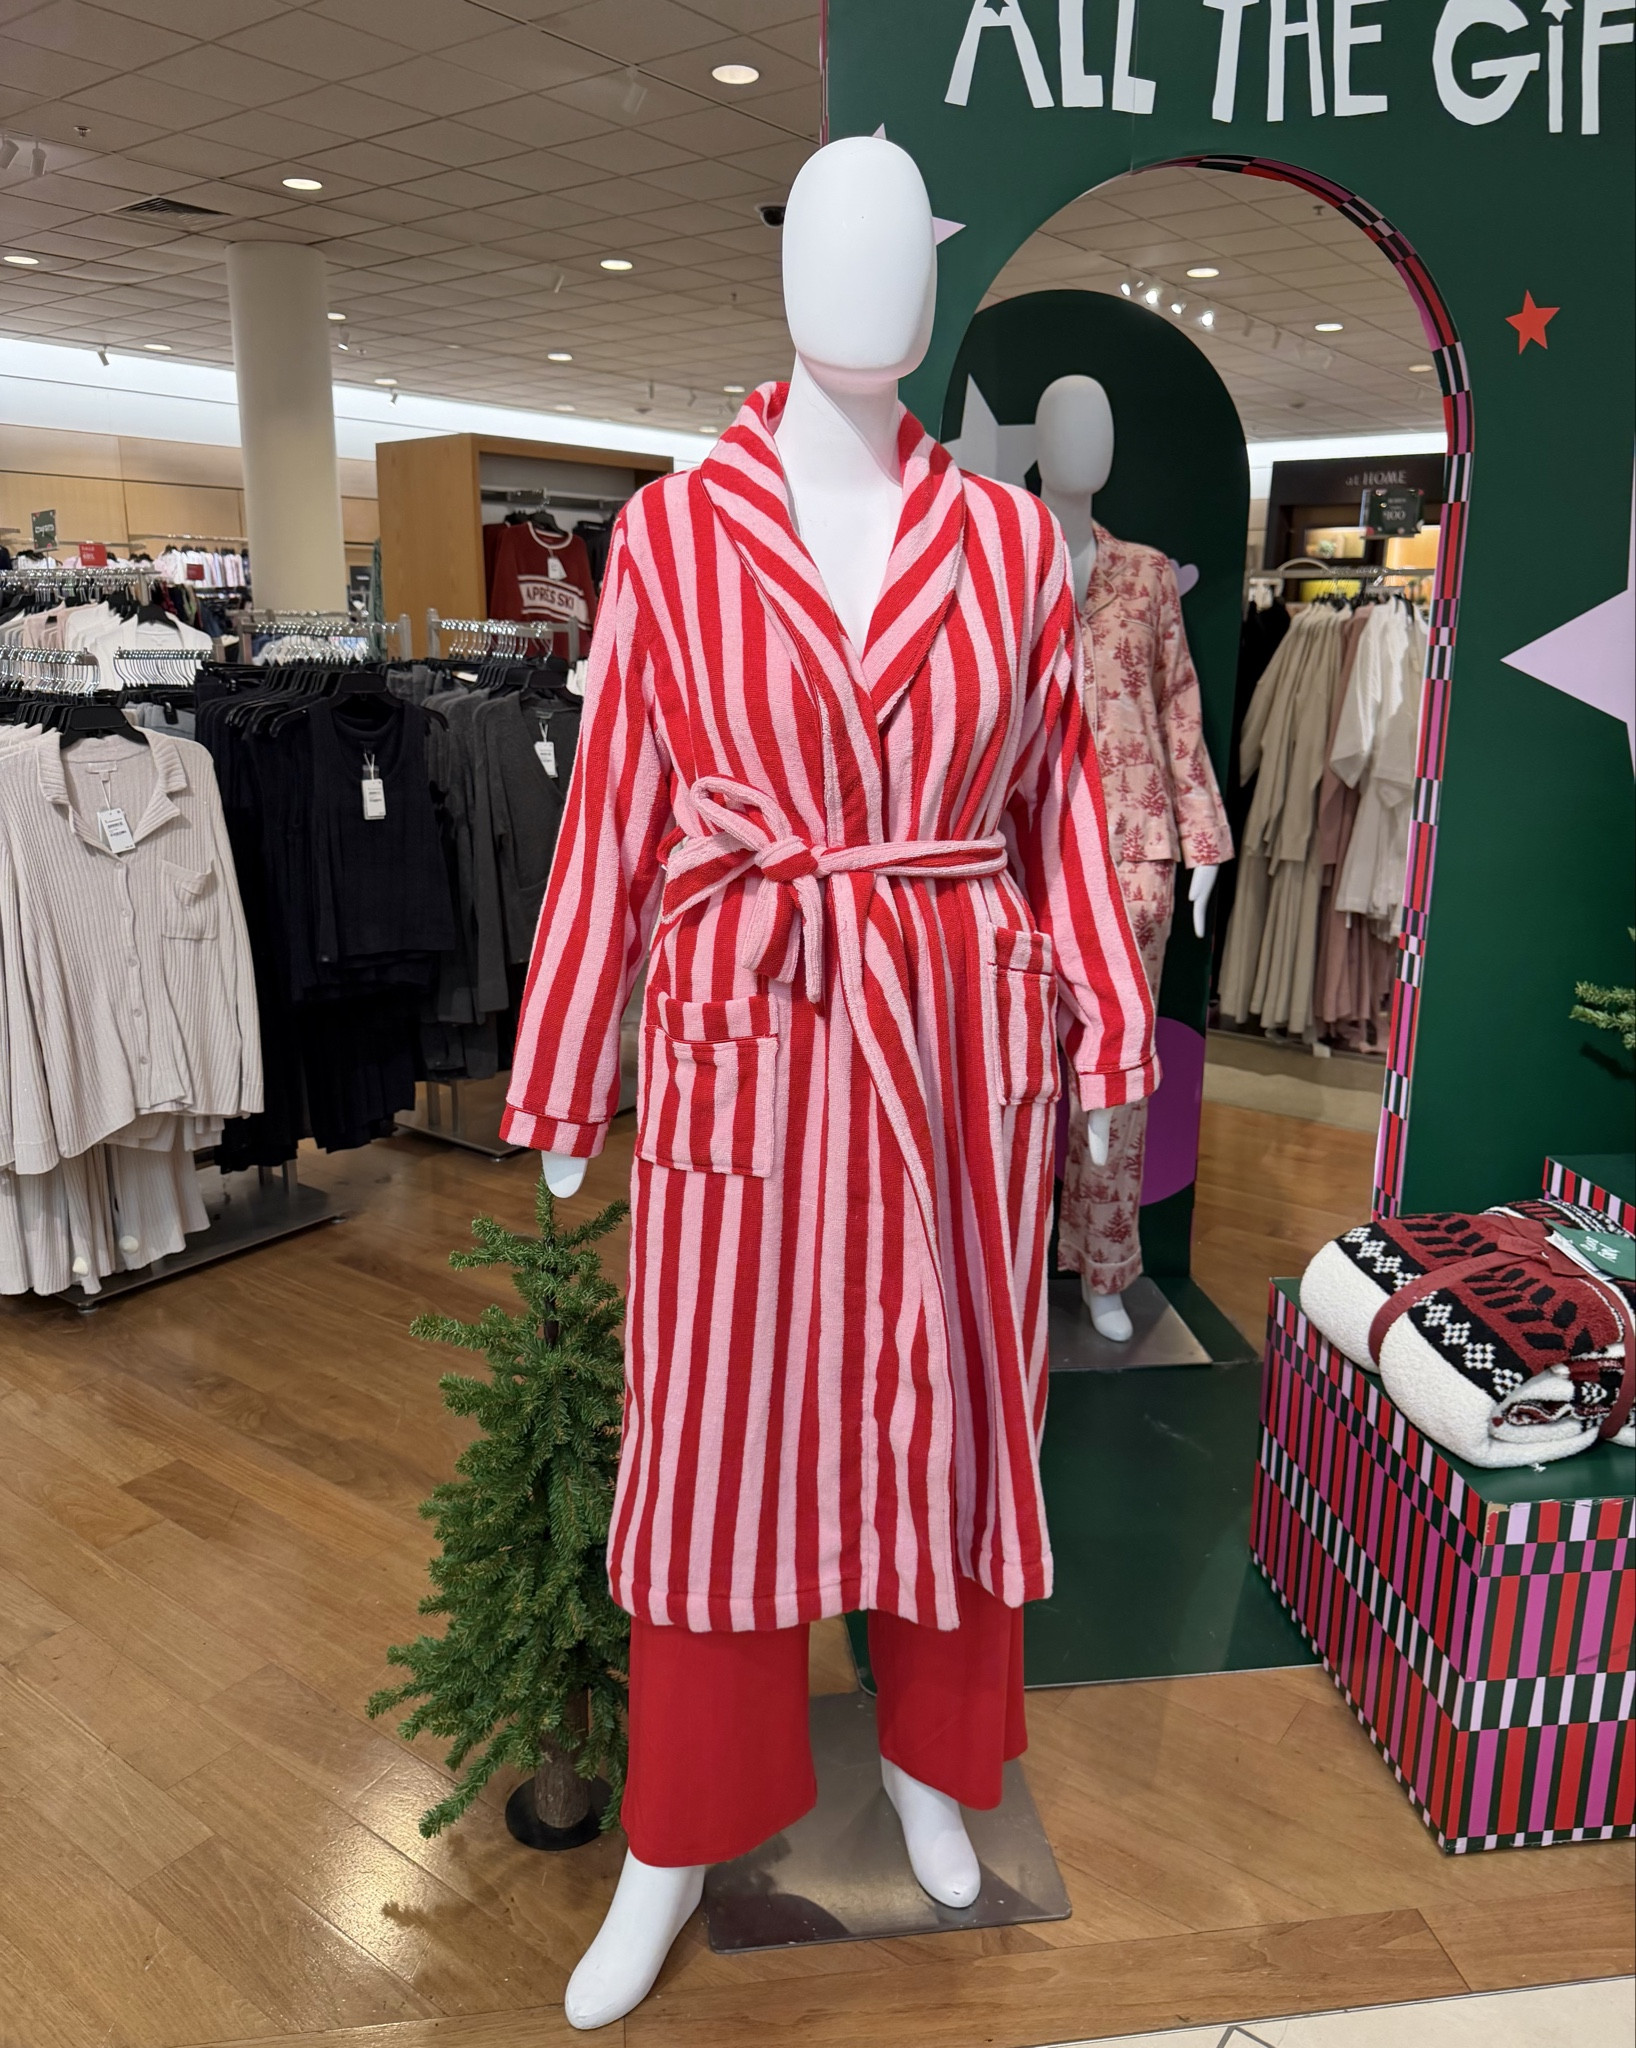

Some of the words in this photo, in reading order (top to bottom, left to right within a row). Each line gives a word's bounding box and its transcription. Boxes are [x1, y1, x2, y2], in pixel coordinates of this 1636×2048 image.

[944, 0, 1157, 115] ALL
[1202, 0, 1390, 124] THE
[1362, 469, 1408, 486] HOME
[557, 593, 575, 611] SKI
